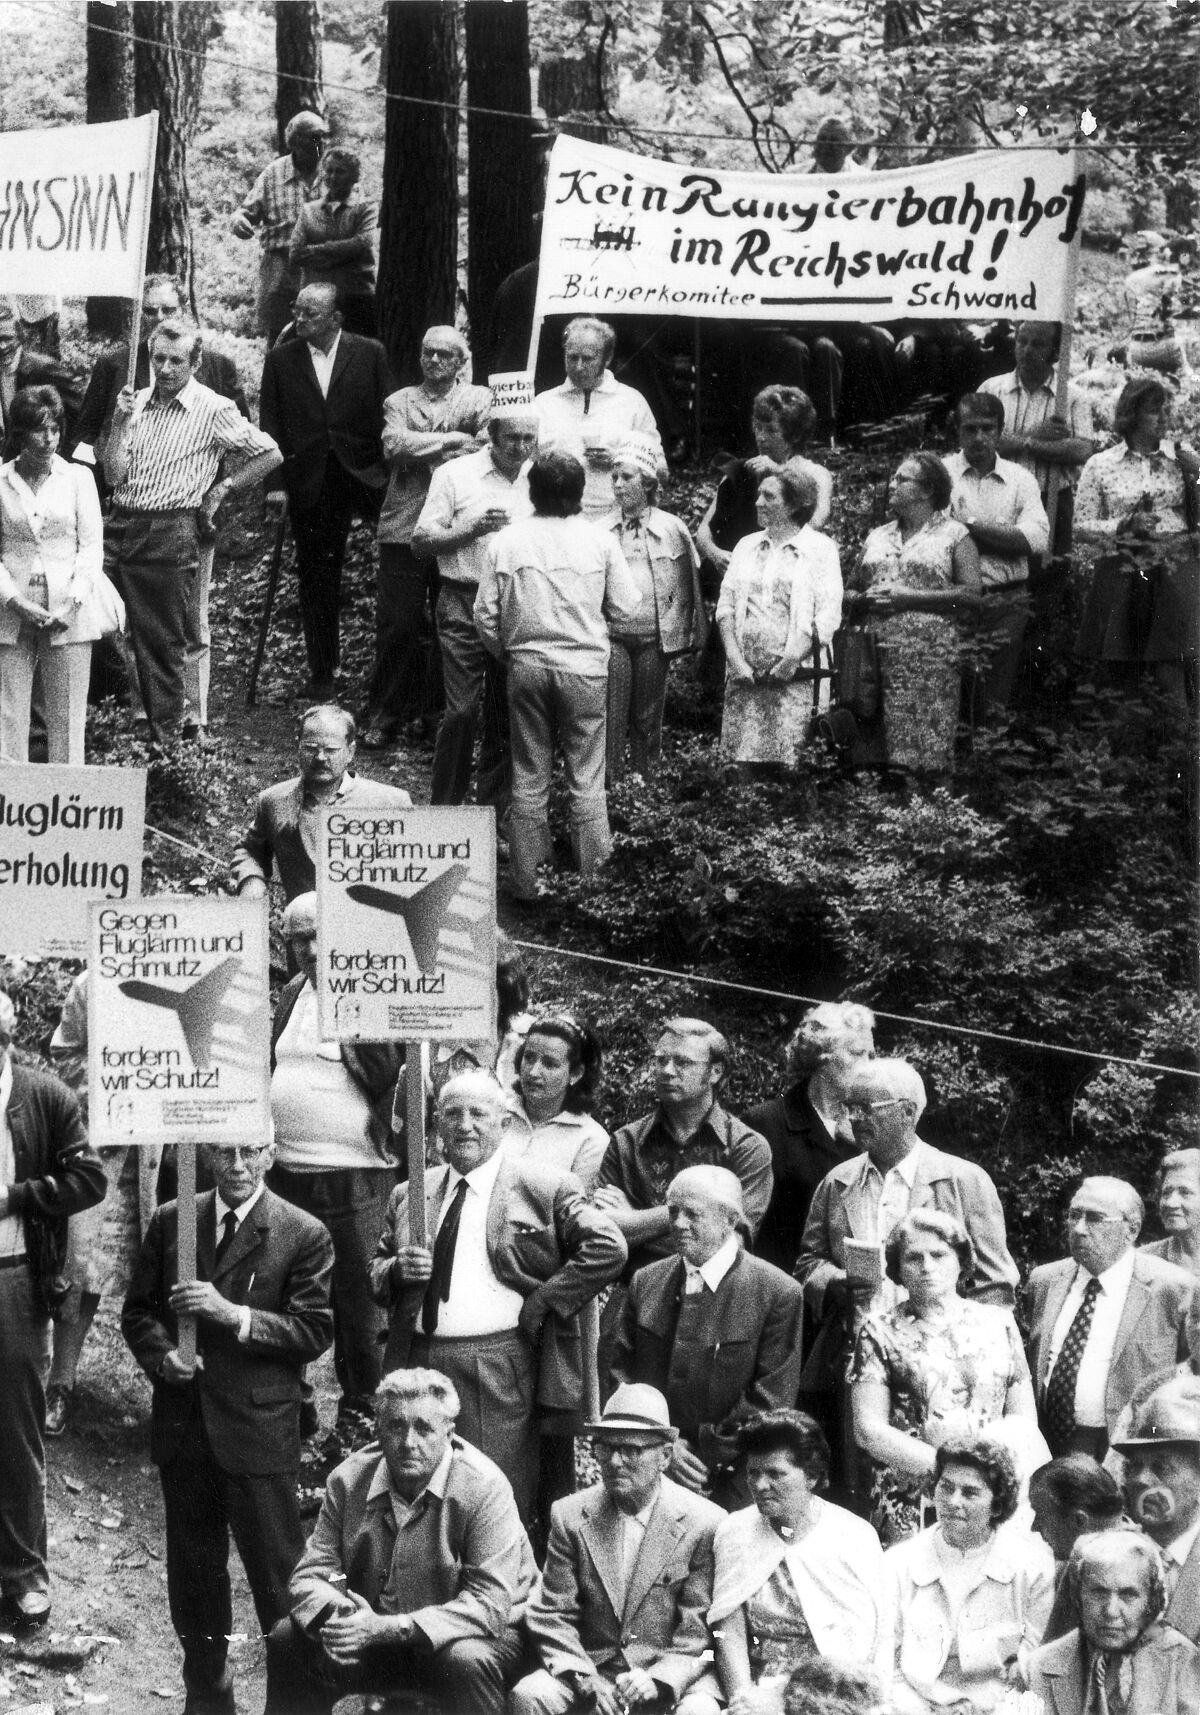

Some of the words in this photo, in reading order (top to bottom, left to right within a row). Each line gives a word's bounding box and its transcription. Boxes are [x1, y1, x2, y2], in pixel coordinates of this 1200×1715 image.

[556, 169, 668, 212] Kein
[672, 173, 1086, 243] Rangierbahnhof
[670, 227, 723, 266] im
[549, 273, 756, 305] Bürgerkomitee
[907, 281, 1037, 311] Schwand
[327, 814, 404, 839] Gegen
[328, 838, 423, 863] Fluglärm
[428, 838, 470, 859] und
[328, 860, 428, 882] Schmutz
[99, 909, 177, 934] Gegen
[100, 931, 196, 958] Fluglärm
[201, 930, 243, 952] und
[101, 956, 200, 978] Schmutz
[329, 949, 406, 970] fordern
[328, 973, 361, 993] wir
[362, 972, 445, 993] Schutz!
[102, 1046, 180, 1067] fordern
[101, 1069, 135, 1090] wir
[136, 1067, 219, 1090] Schutz!
